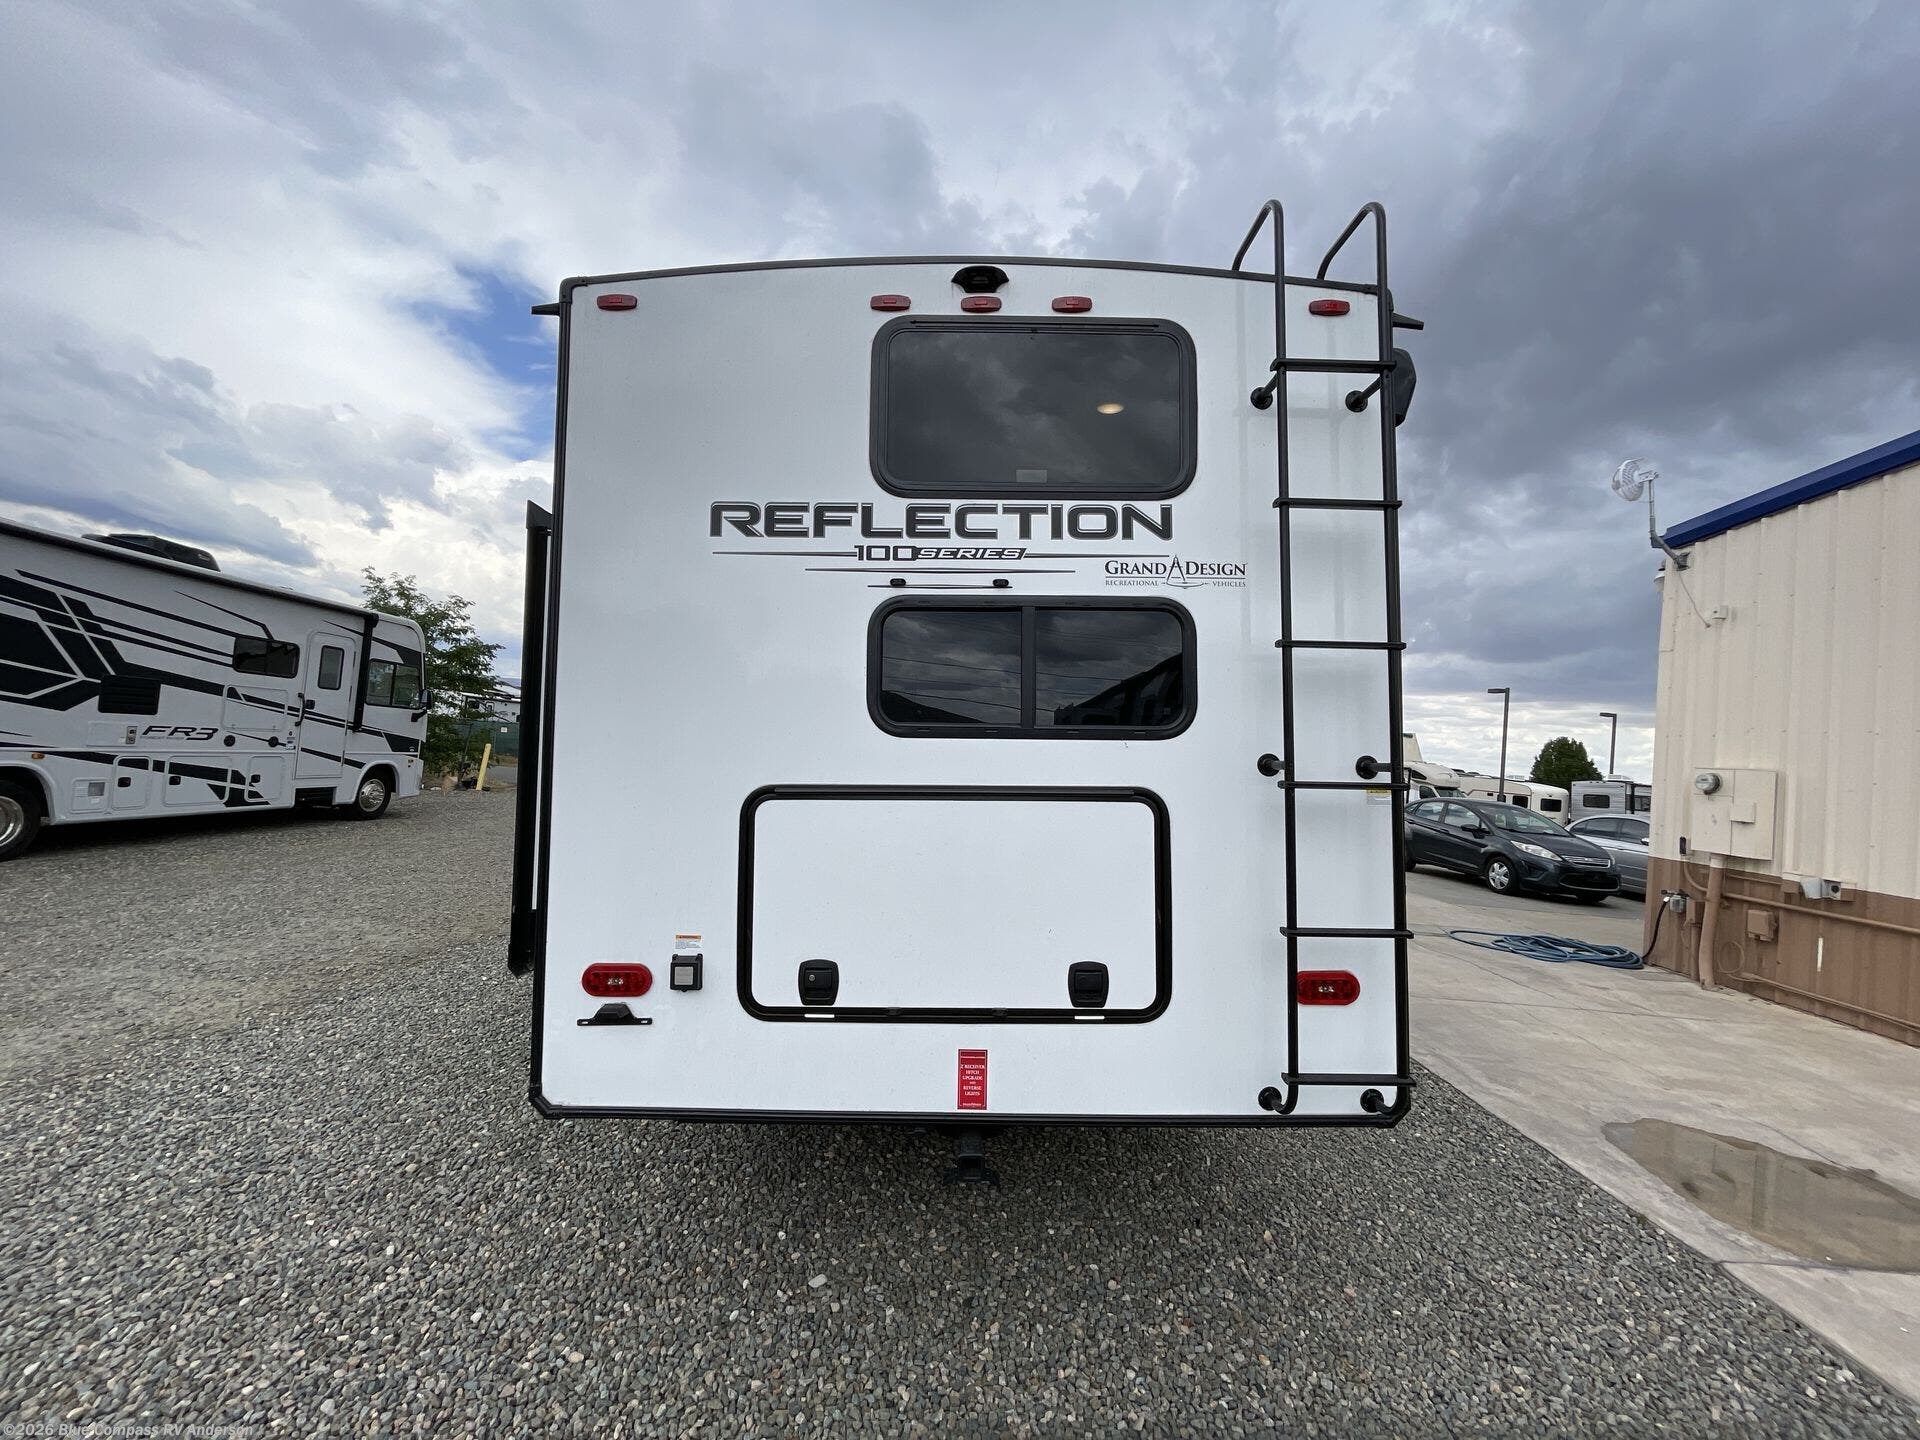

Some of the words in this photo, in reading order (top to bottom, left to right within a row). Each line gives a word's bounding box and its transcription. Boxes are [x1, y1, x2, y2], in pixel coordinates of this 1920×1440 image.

[709, 500, 1174, 541] REFLECTION
[854, 545, 917, 561] 100
[917, 548, 1022, 560] SERIES
[1104, 560, 1167, 575] GRAND
[1185, 560, 1246, 576] DESIGN
[1105, 579, 1160, 587] RECREATIONAL
[1212, 580, 1246, 588] VEHICLES
[142, 725, 219, 741] FR3
